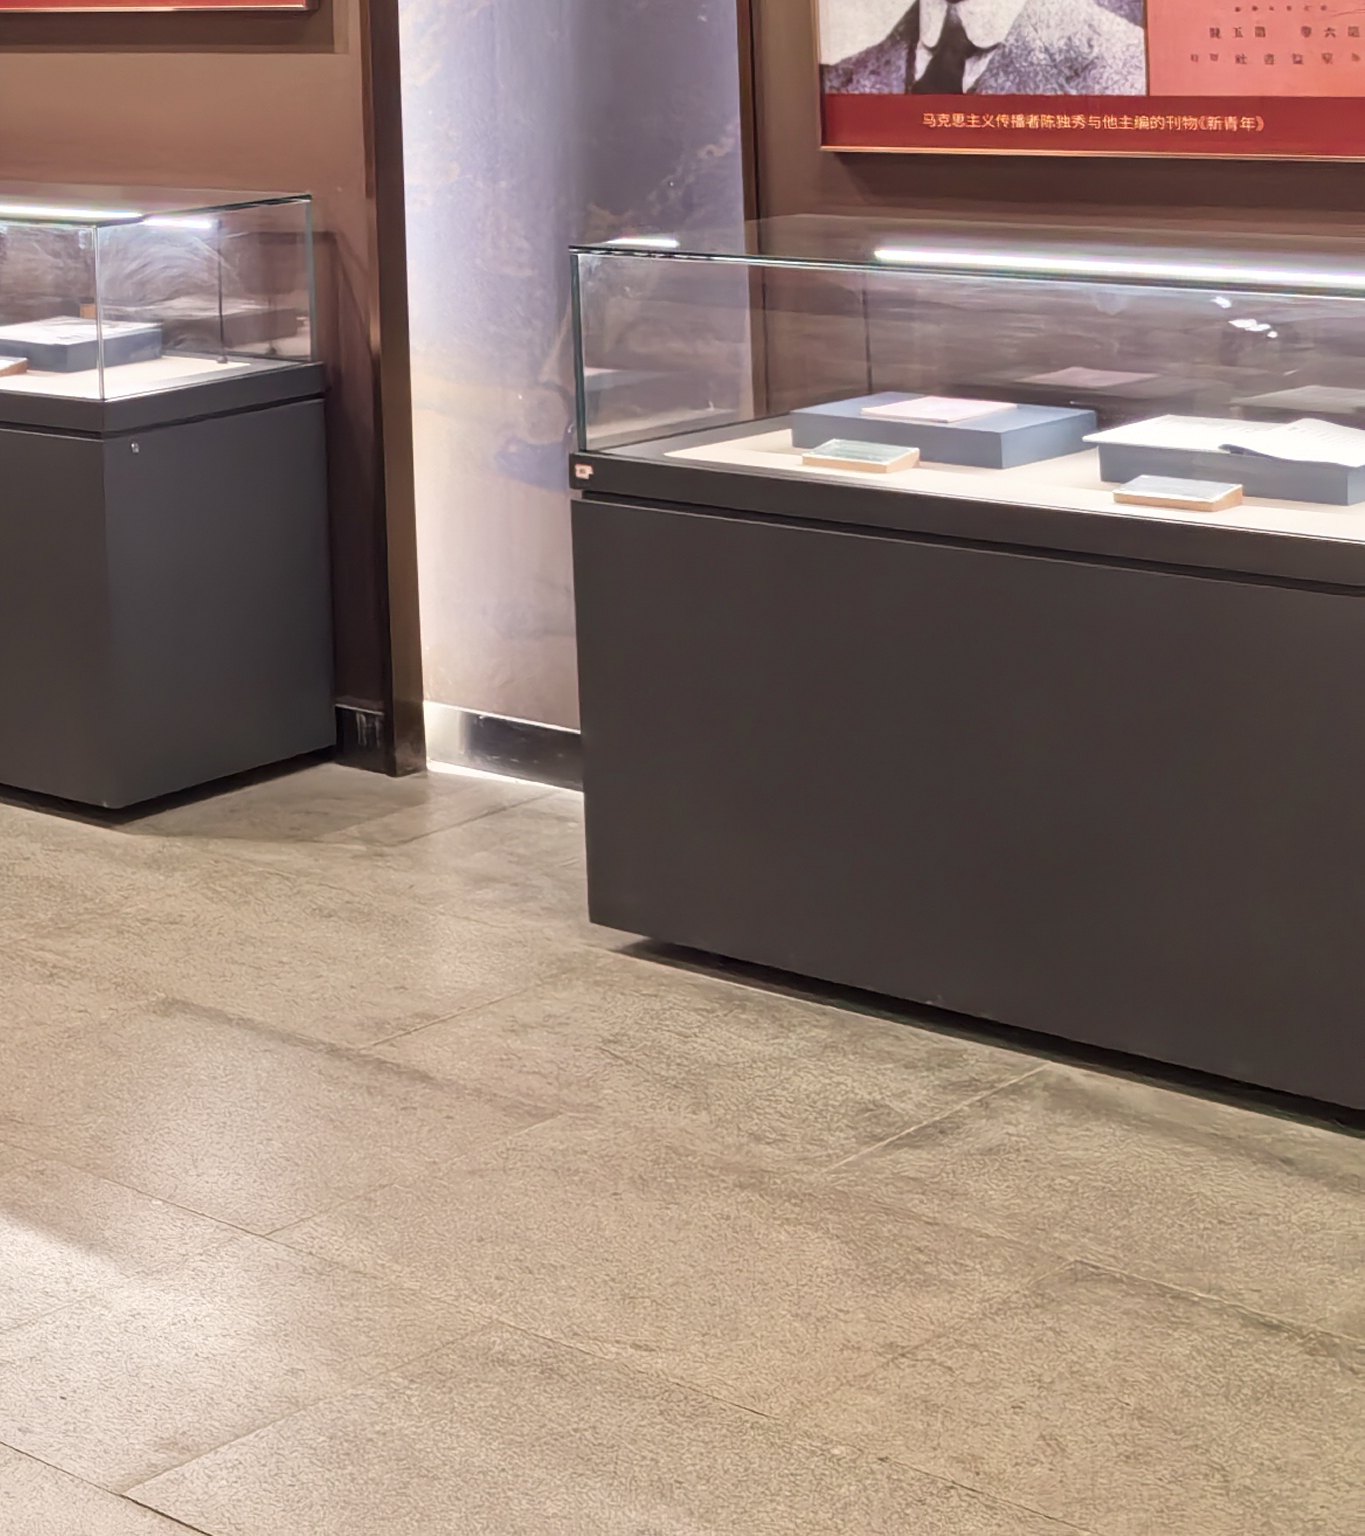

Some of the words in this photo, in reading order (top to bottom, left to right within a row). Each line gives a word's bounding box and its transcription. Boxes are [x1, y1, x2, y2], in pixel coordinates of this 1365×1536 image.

[921, 111, 1266, 132] 马克思主义传播者陈独秀与他主编的刊物《新青年》
